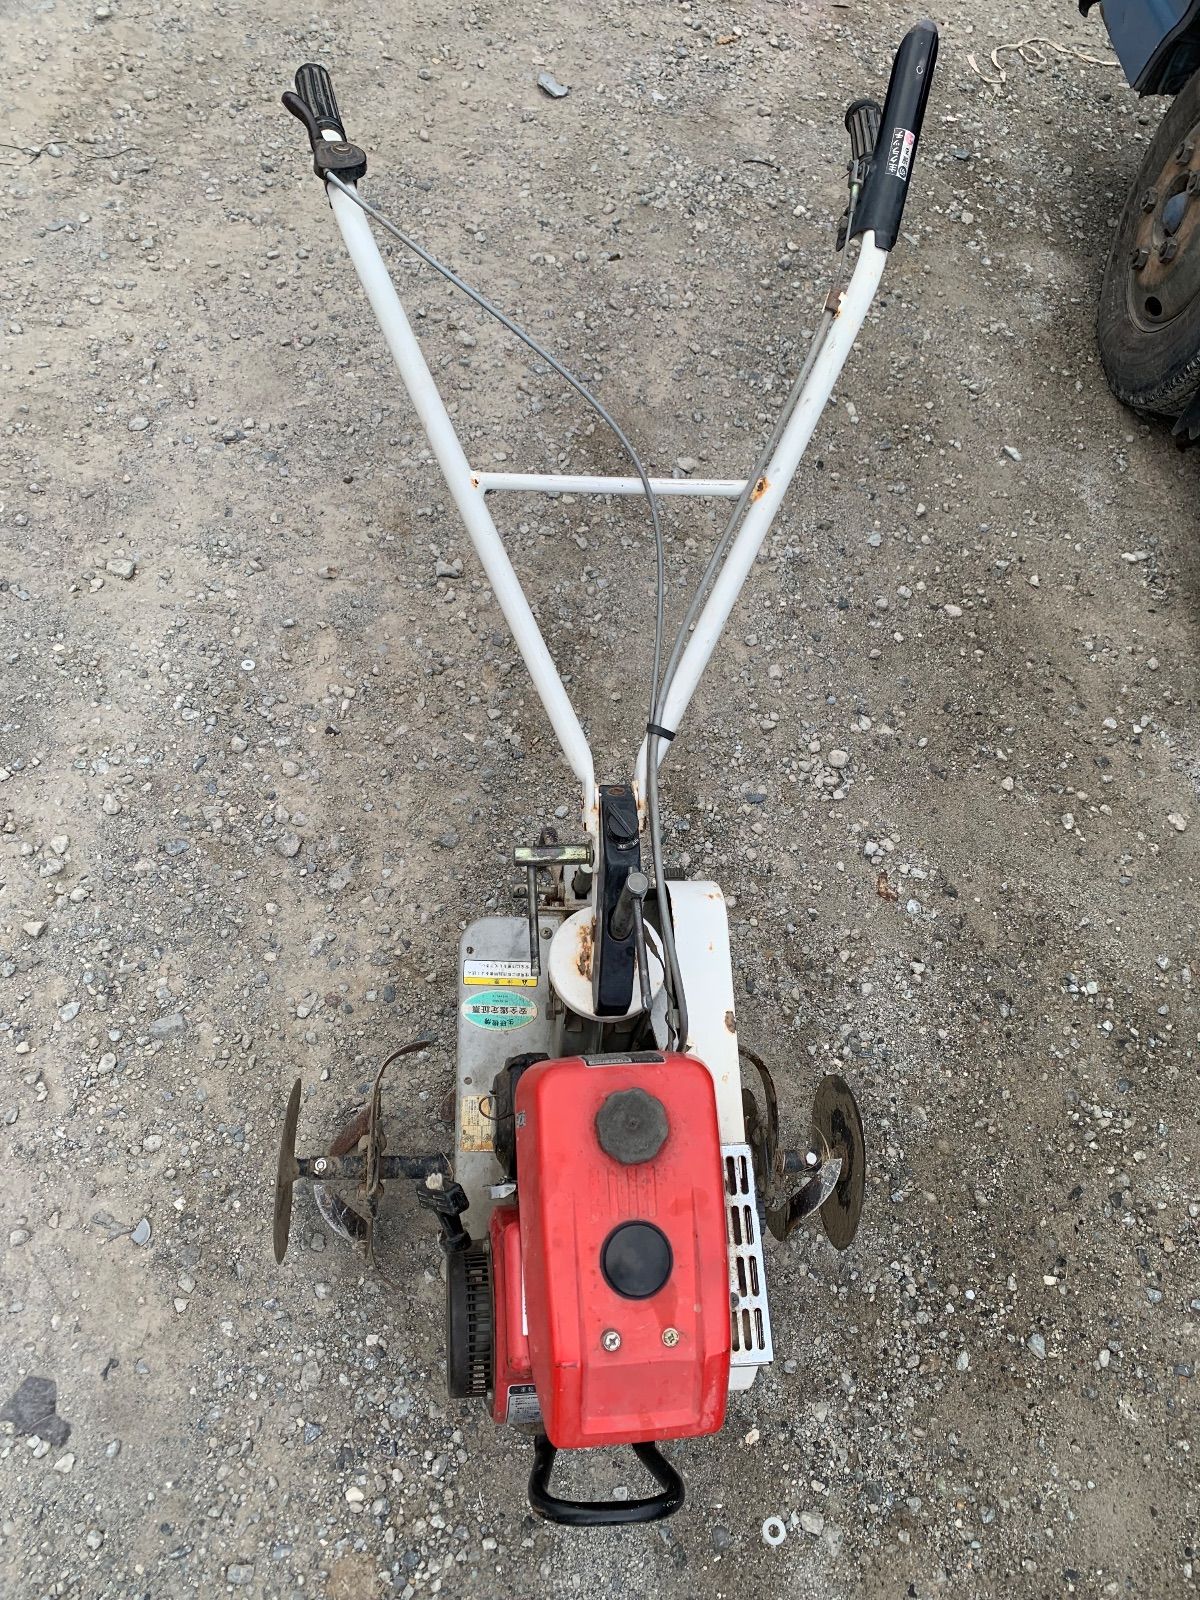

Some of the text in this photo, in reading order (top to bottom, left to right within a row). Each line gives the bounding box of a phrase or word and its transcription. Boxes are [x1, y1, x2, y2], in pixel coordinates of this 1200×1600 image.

[472, 1005, 527, 1014] 安全鑑定証票
[484, 1018, 514, 1026] 生研機構
